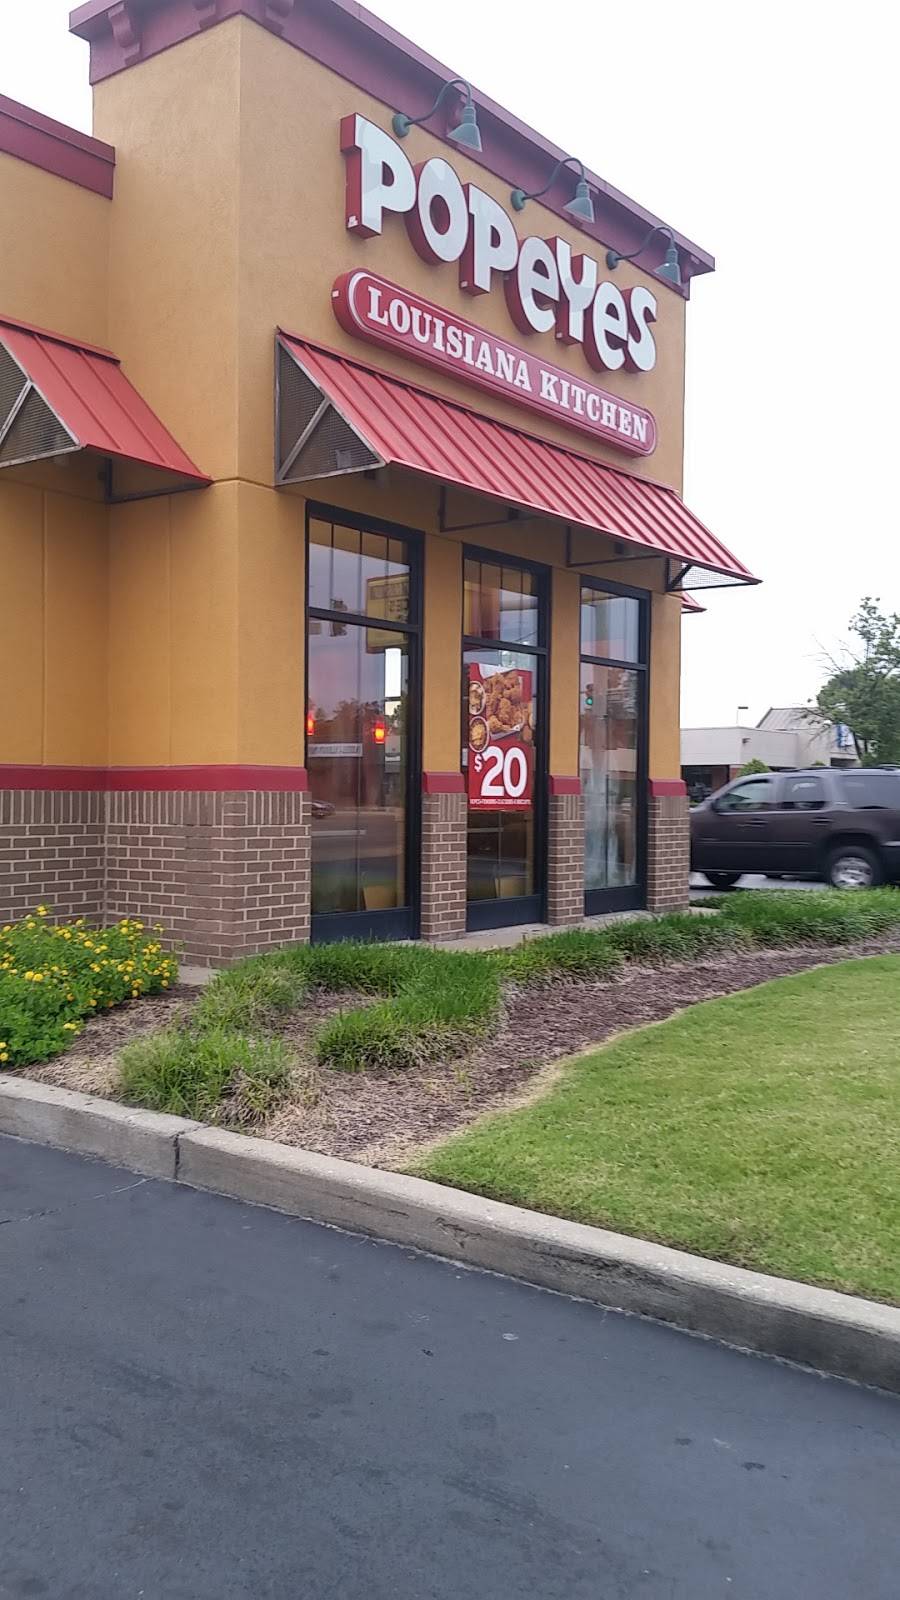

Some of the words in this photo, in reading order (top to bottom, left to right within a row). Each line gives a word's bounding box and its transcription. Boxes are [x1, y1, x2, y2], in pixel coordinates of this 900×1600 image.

[367, 286, 532, 392] LOUISIANA
[539, 369, 649, 442] KITCHEN
[474, 746, 528, 797] $20
